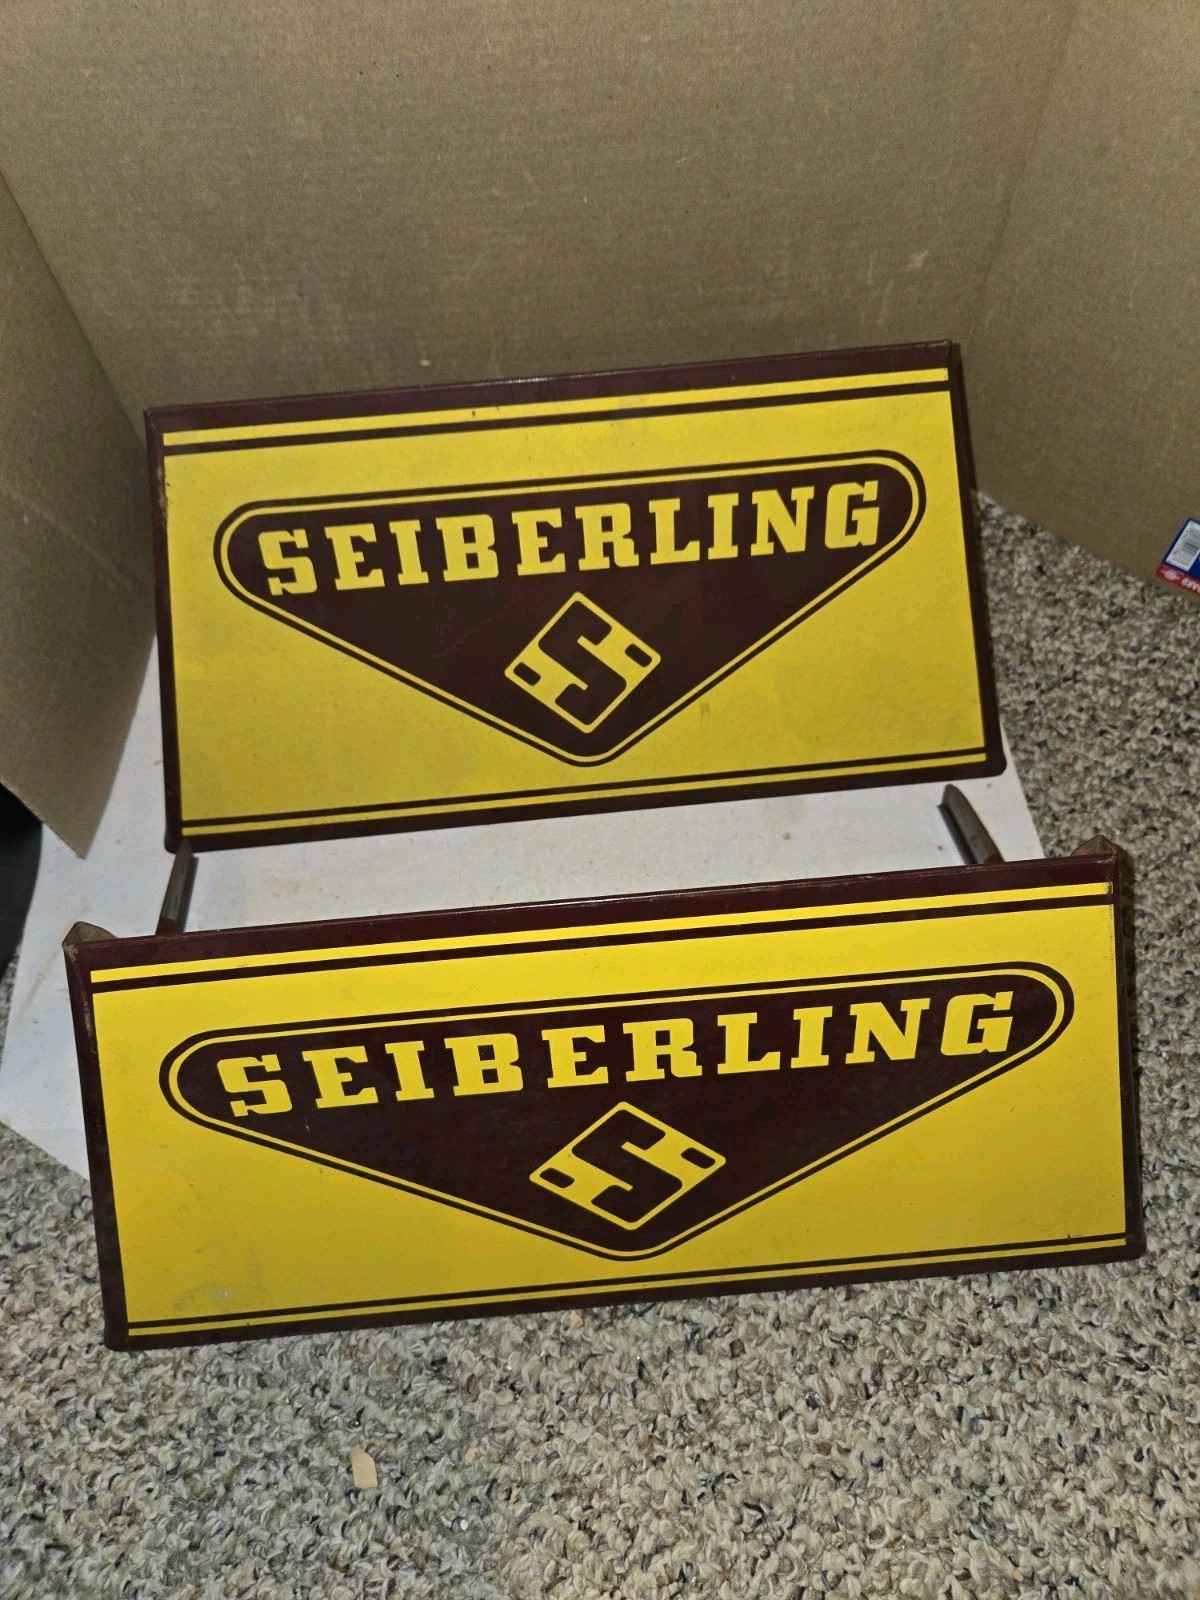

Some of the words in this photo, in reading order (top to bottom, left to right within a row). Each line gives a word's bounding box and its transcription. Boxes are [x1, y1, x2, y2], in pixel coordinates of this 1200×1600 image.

[258, 480, 880, 597] SEIBERLING
[535, 598, 630, 728] S
[215, 990, 1014, 1118] SEIBERLING
[569, 1106, 685, 1225] S
